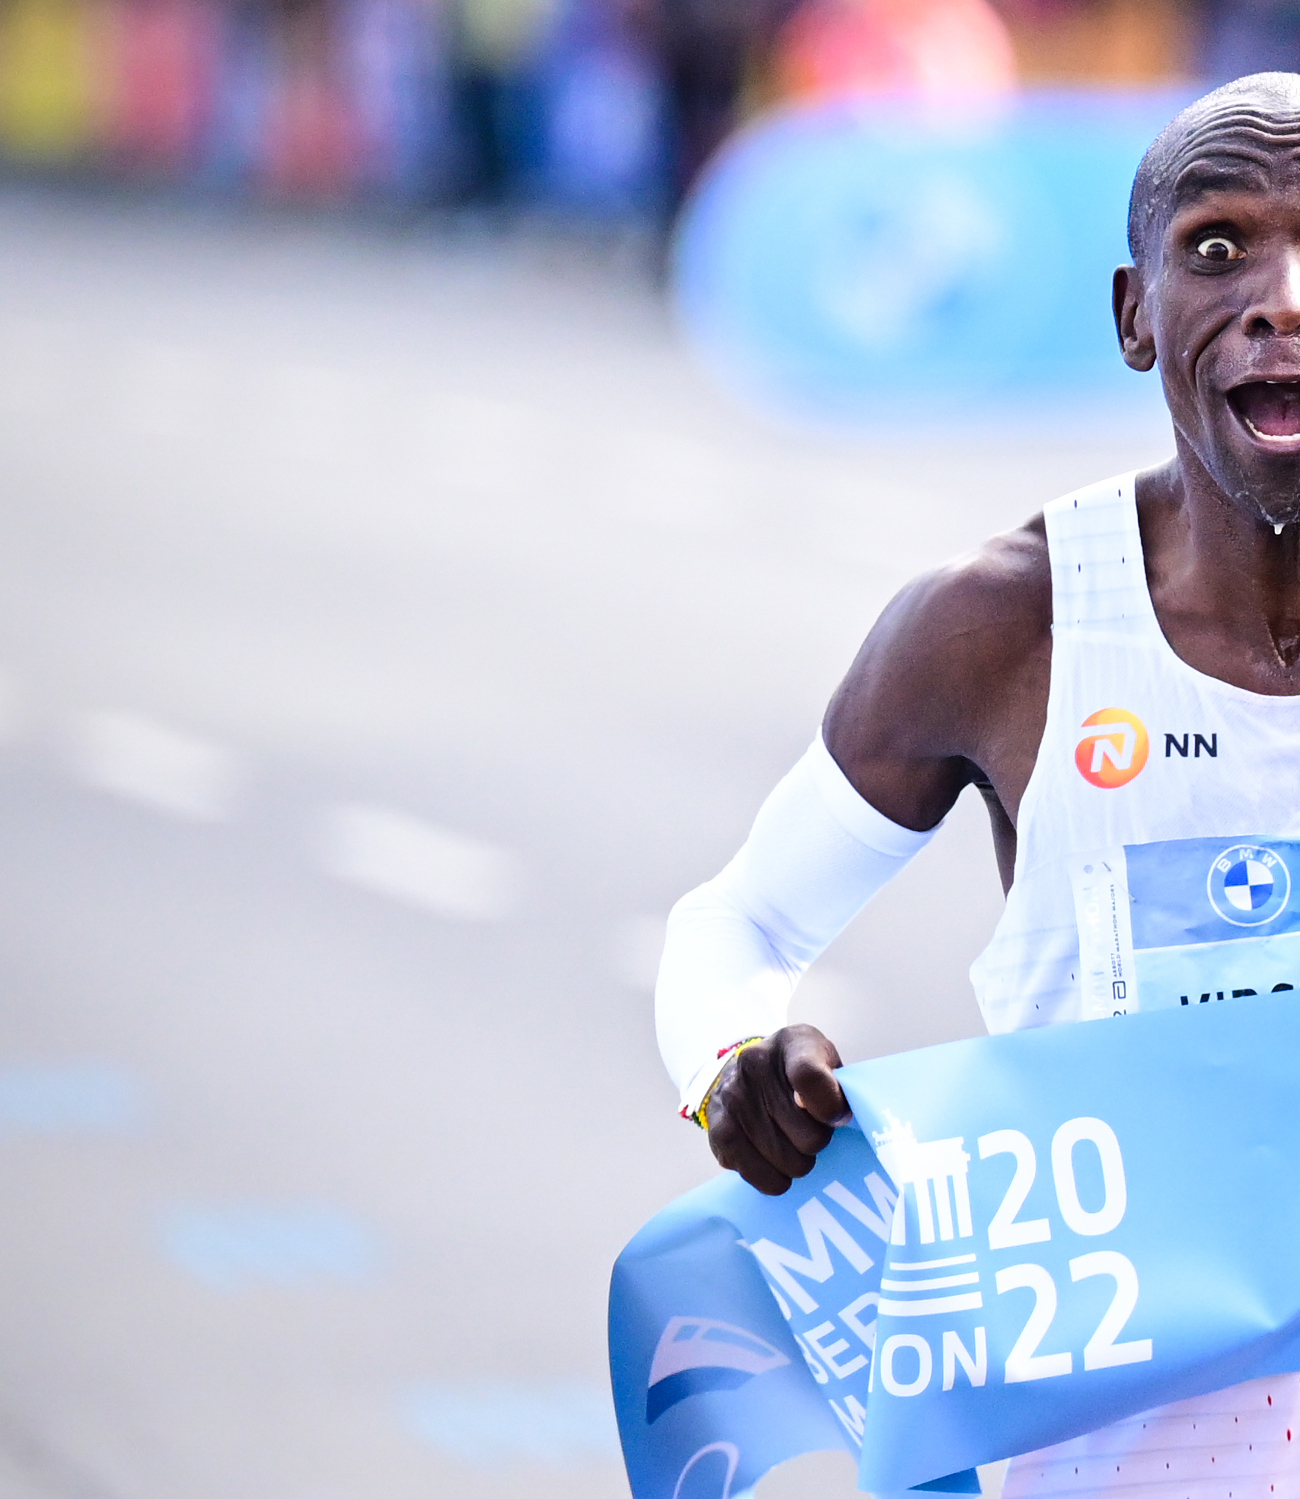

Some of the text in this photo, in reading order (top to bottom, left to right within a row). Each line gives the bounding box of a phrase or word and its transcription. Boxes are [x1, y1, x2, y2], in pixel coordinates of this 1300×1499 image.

[1163, 732, 1218, 758] NN
[1216, 848, 1278, 873] BMW
[750, 1171, 899, 1321] MW
[976, 1116, 1128, 1251] 20
[994, 1250, 1153, 1384] 22
